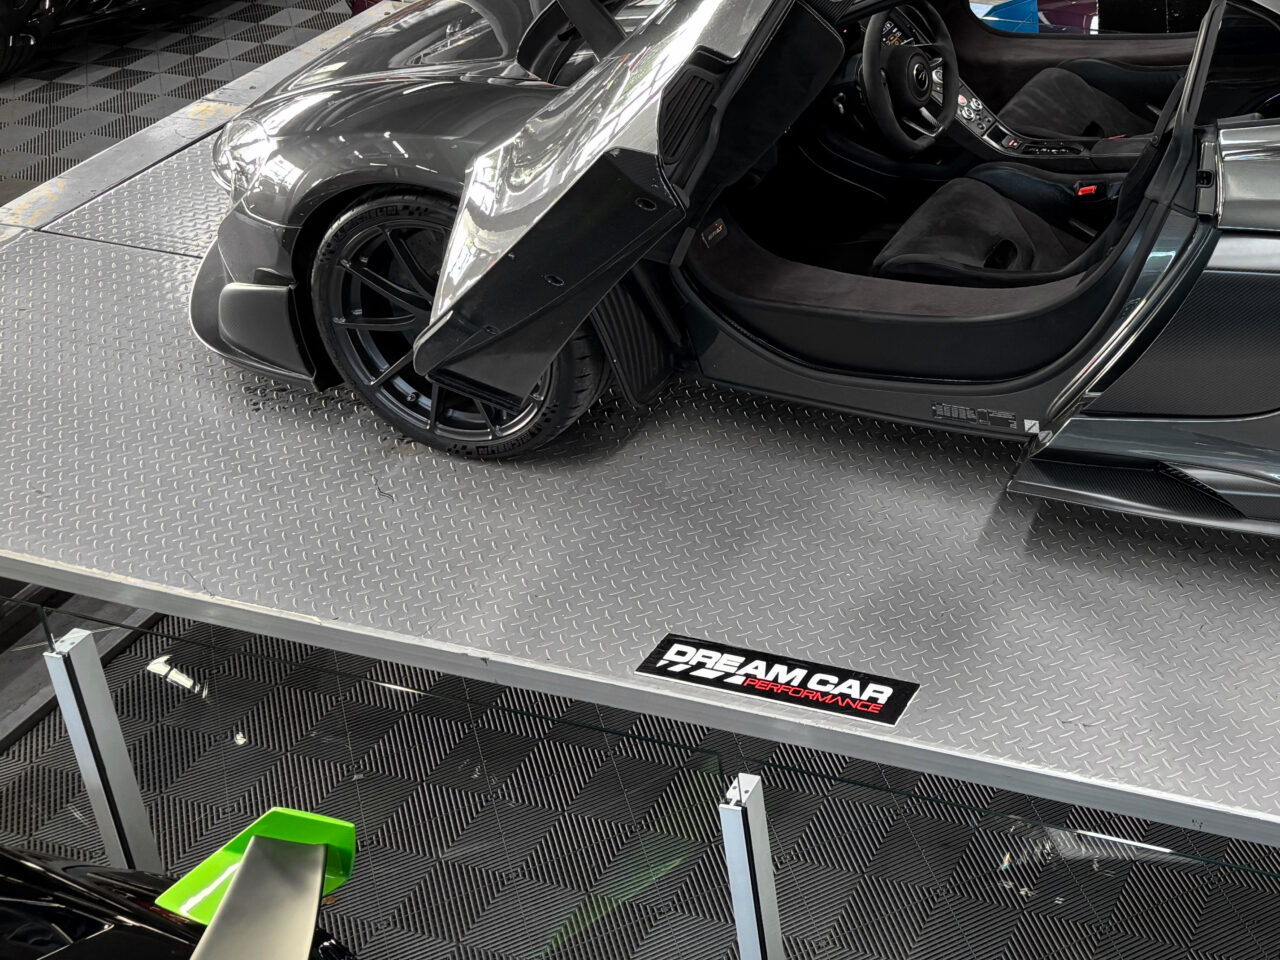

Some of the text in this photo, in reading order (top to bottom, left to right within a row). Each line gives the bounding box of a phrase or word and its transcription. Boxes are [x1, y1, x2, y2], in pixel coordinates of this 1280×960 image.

[662, 642, 894, 705] DREAM CAR
[742, 677, 883, 714] PERFORMANCE
